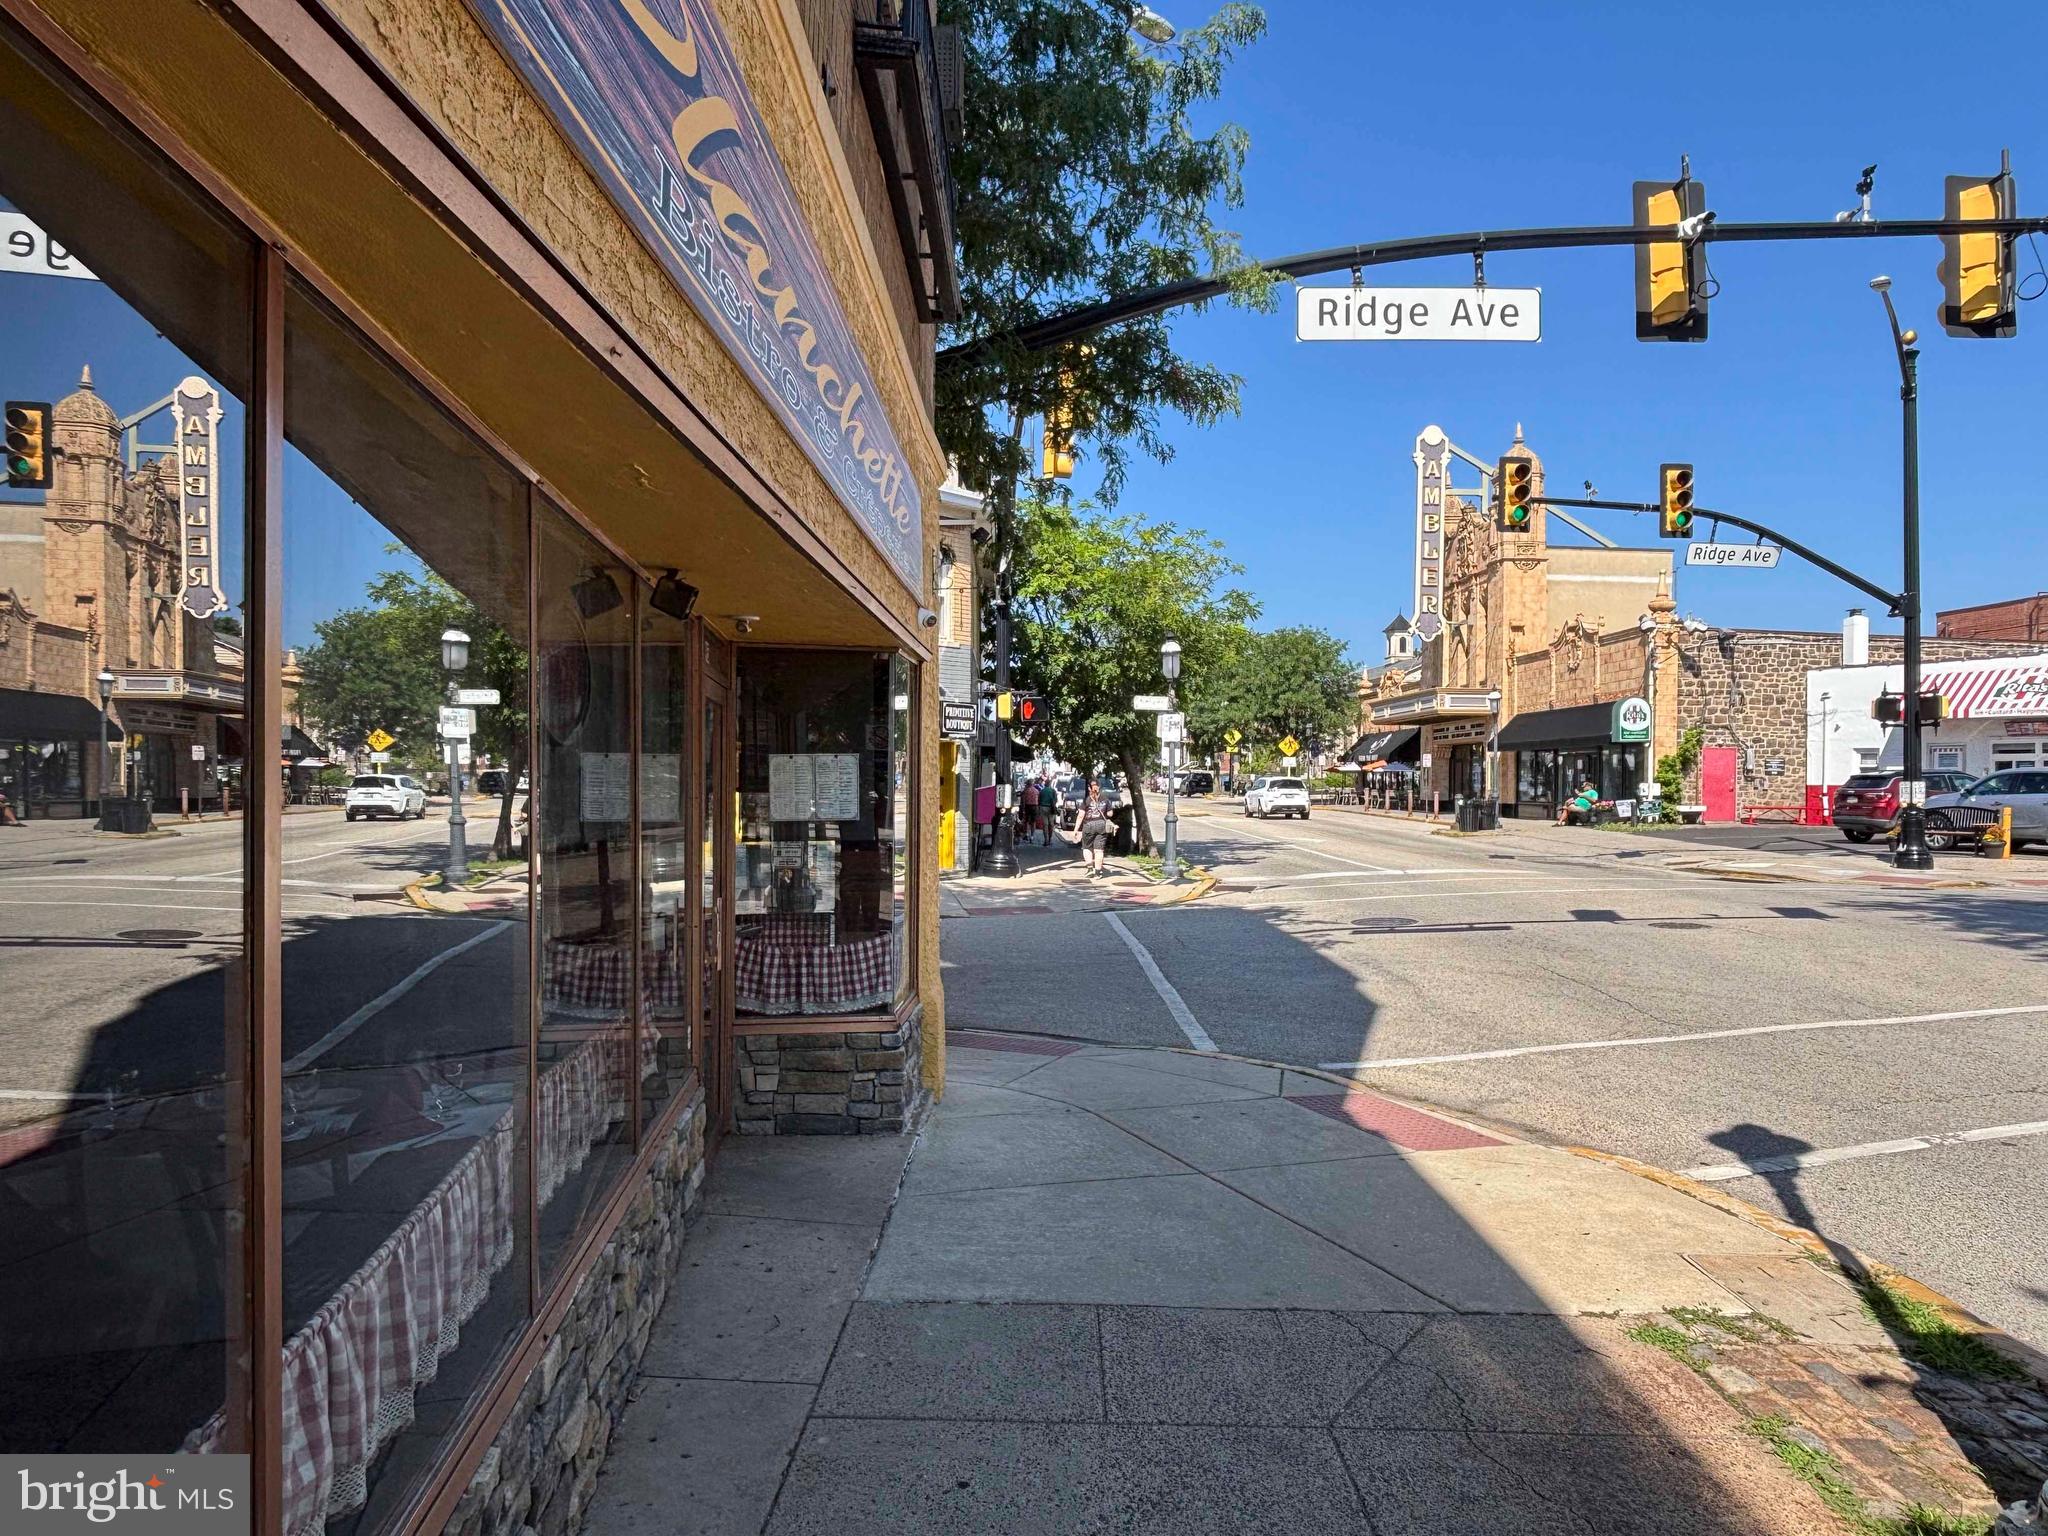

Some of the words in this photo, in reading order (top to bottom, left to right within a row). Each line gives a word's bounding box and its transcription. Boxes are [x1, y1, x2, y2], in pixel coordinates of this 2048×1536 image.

[653, 145, 801, 410] Bistro
[813, 404, 839, 459] &
[1318, 296, 1429, 334] Ridge
[1451, 297, 1519, 328] Ave
[1422, 460, 1441, 614] AMBLER
[1693, 546, 1736, 564] Ridge
[1742, 549, 1771, 562] Ave
[946, 719, 974, 731] BOUTIQUE
